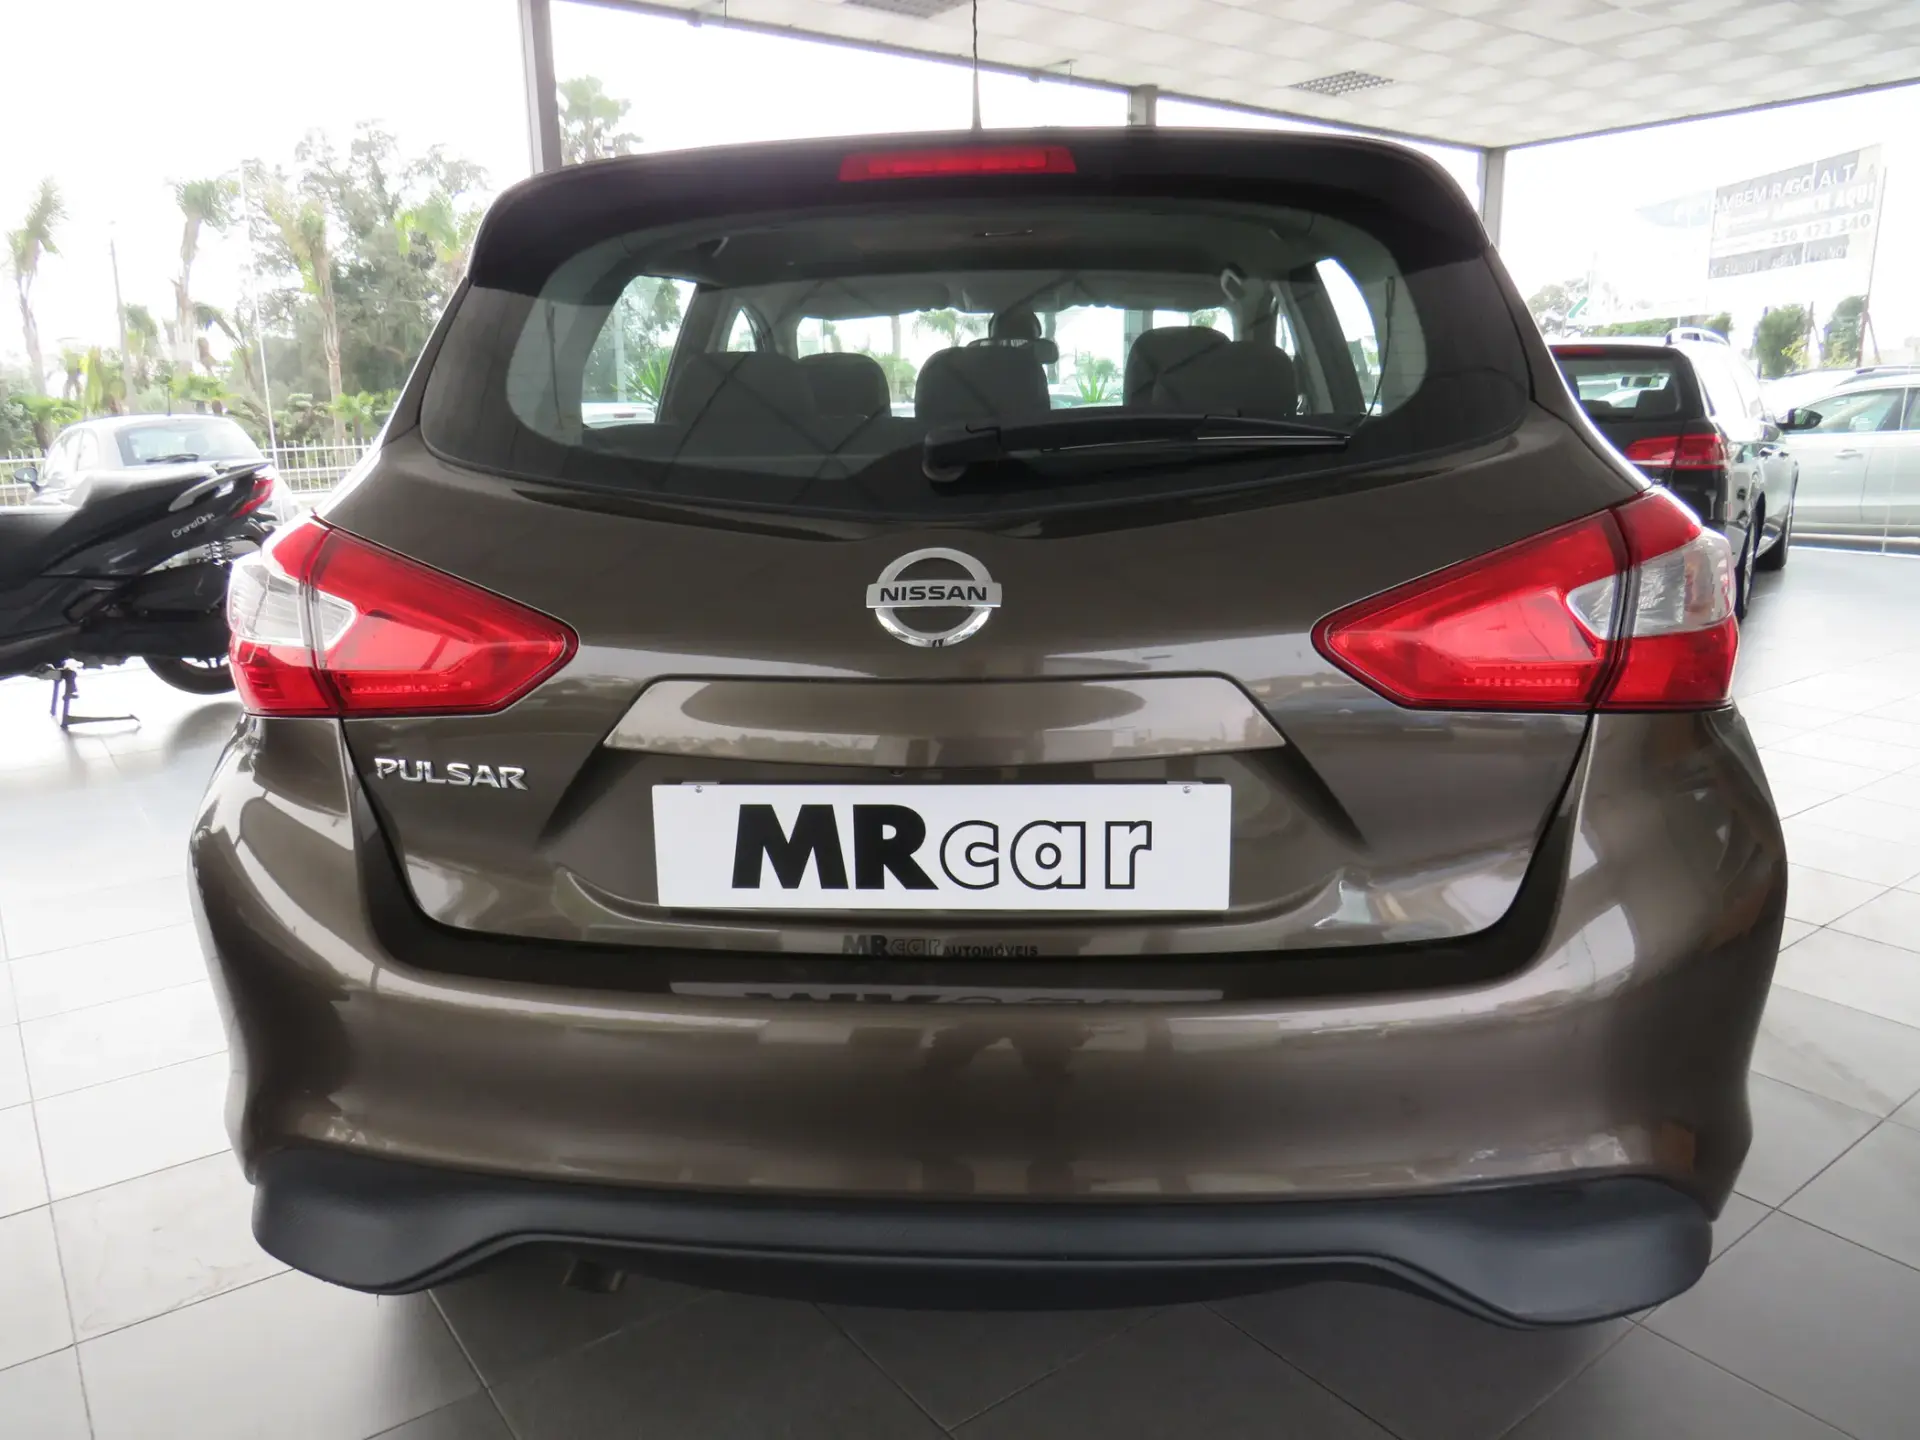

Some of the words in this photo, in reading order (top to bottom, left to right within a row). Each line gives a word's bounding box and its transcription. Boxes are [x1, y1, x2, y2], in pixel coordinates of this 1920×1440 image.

[880, 585, 987, 602] NISSAN
[374, 757, 528, 791] PULSAR
[731, 803, 1152, 890] MRcar
